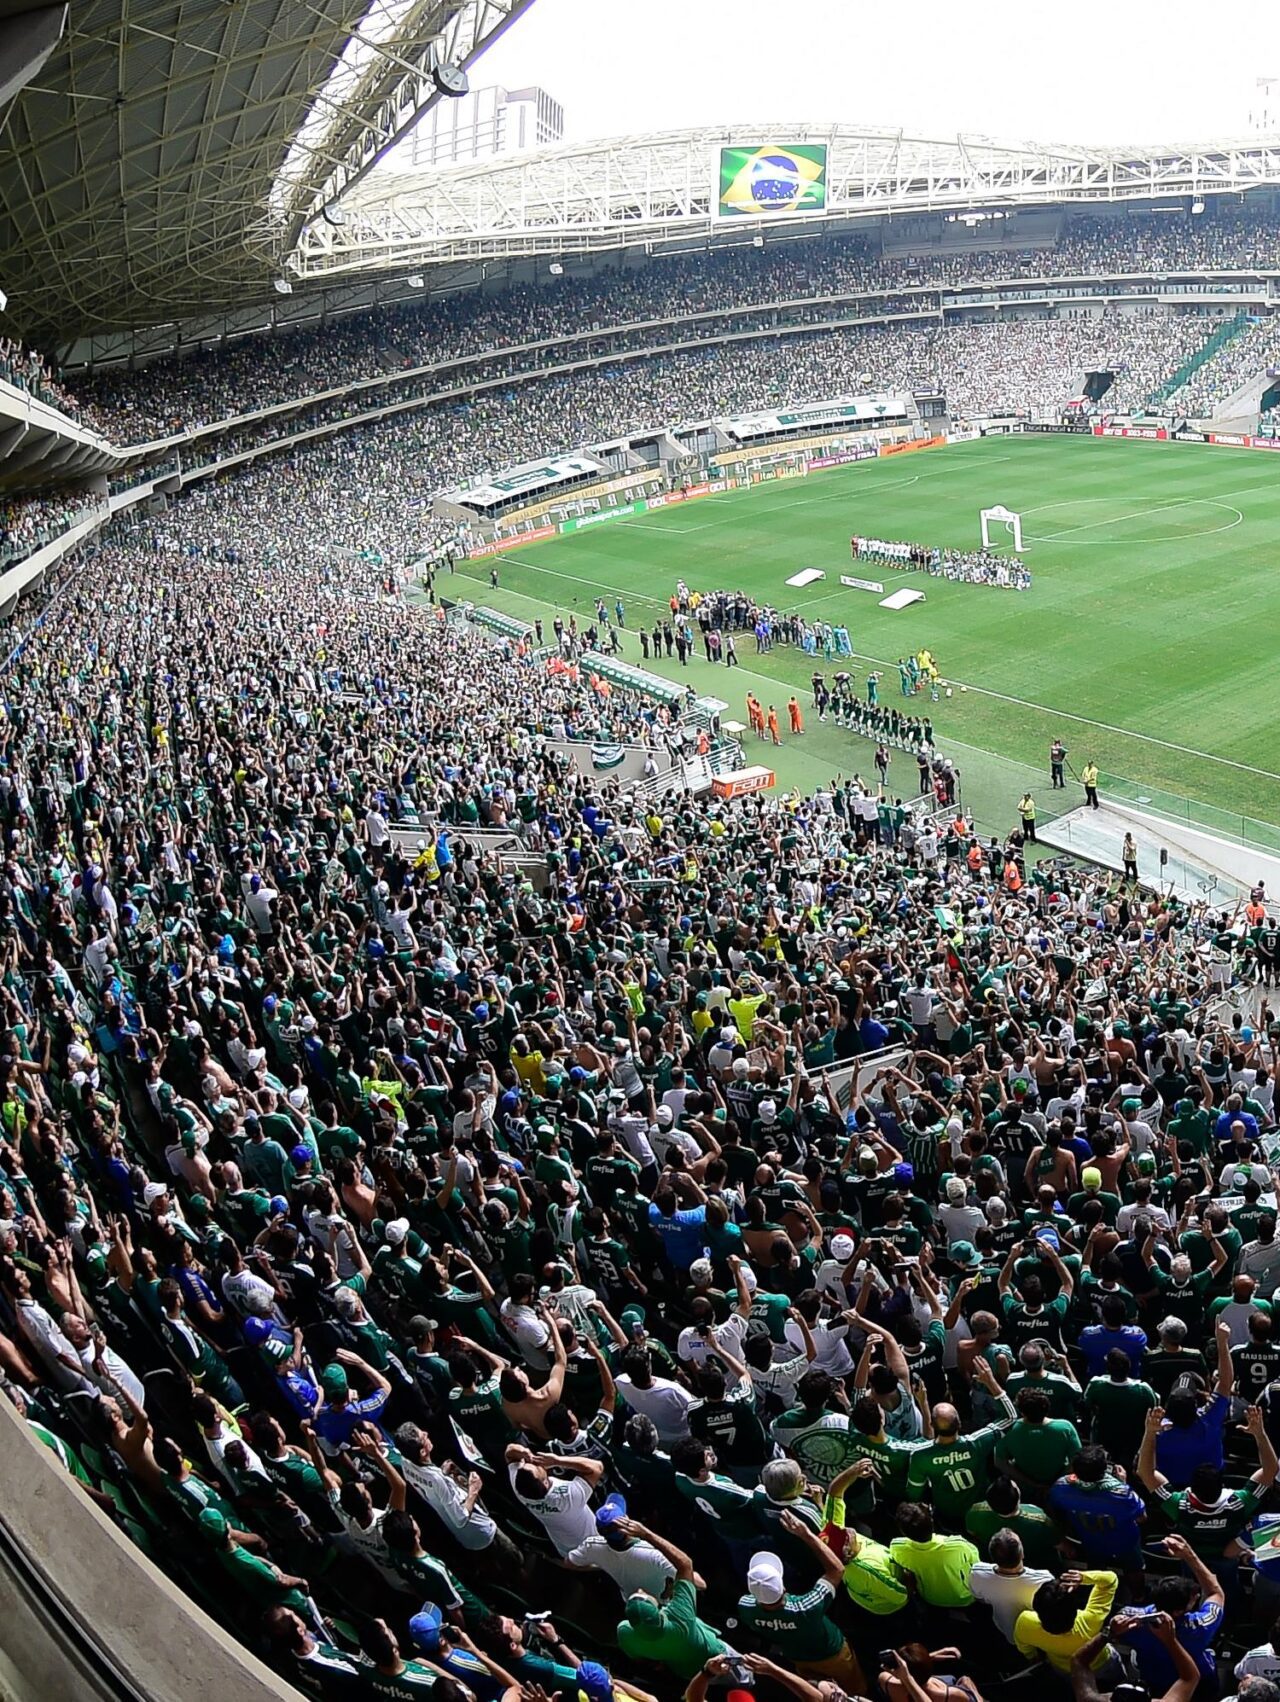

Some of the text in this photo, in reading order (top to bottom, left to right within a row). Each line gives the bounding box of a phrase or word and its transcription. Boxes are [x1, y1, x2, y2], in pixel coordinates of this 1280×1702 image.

[1017, 1318, 1050, 1329] crefisa
[1250, 1362, 1268, 1384] 9
[459, 1402, 492, 1416] crefisa
[706, 1411, 735, 1426] CASE
[714, 1426, 737, 1446] 7
[855, 1443, 891, 1464] crefisa
[932, 1450, 972, 1466] crefisa
[942, 1467, 976, 1493] 10
[754, 1617, 798, 1631] crefisa
